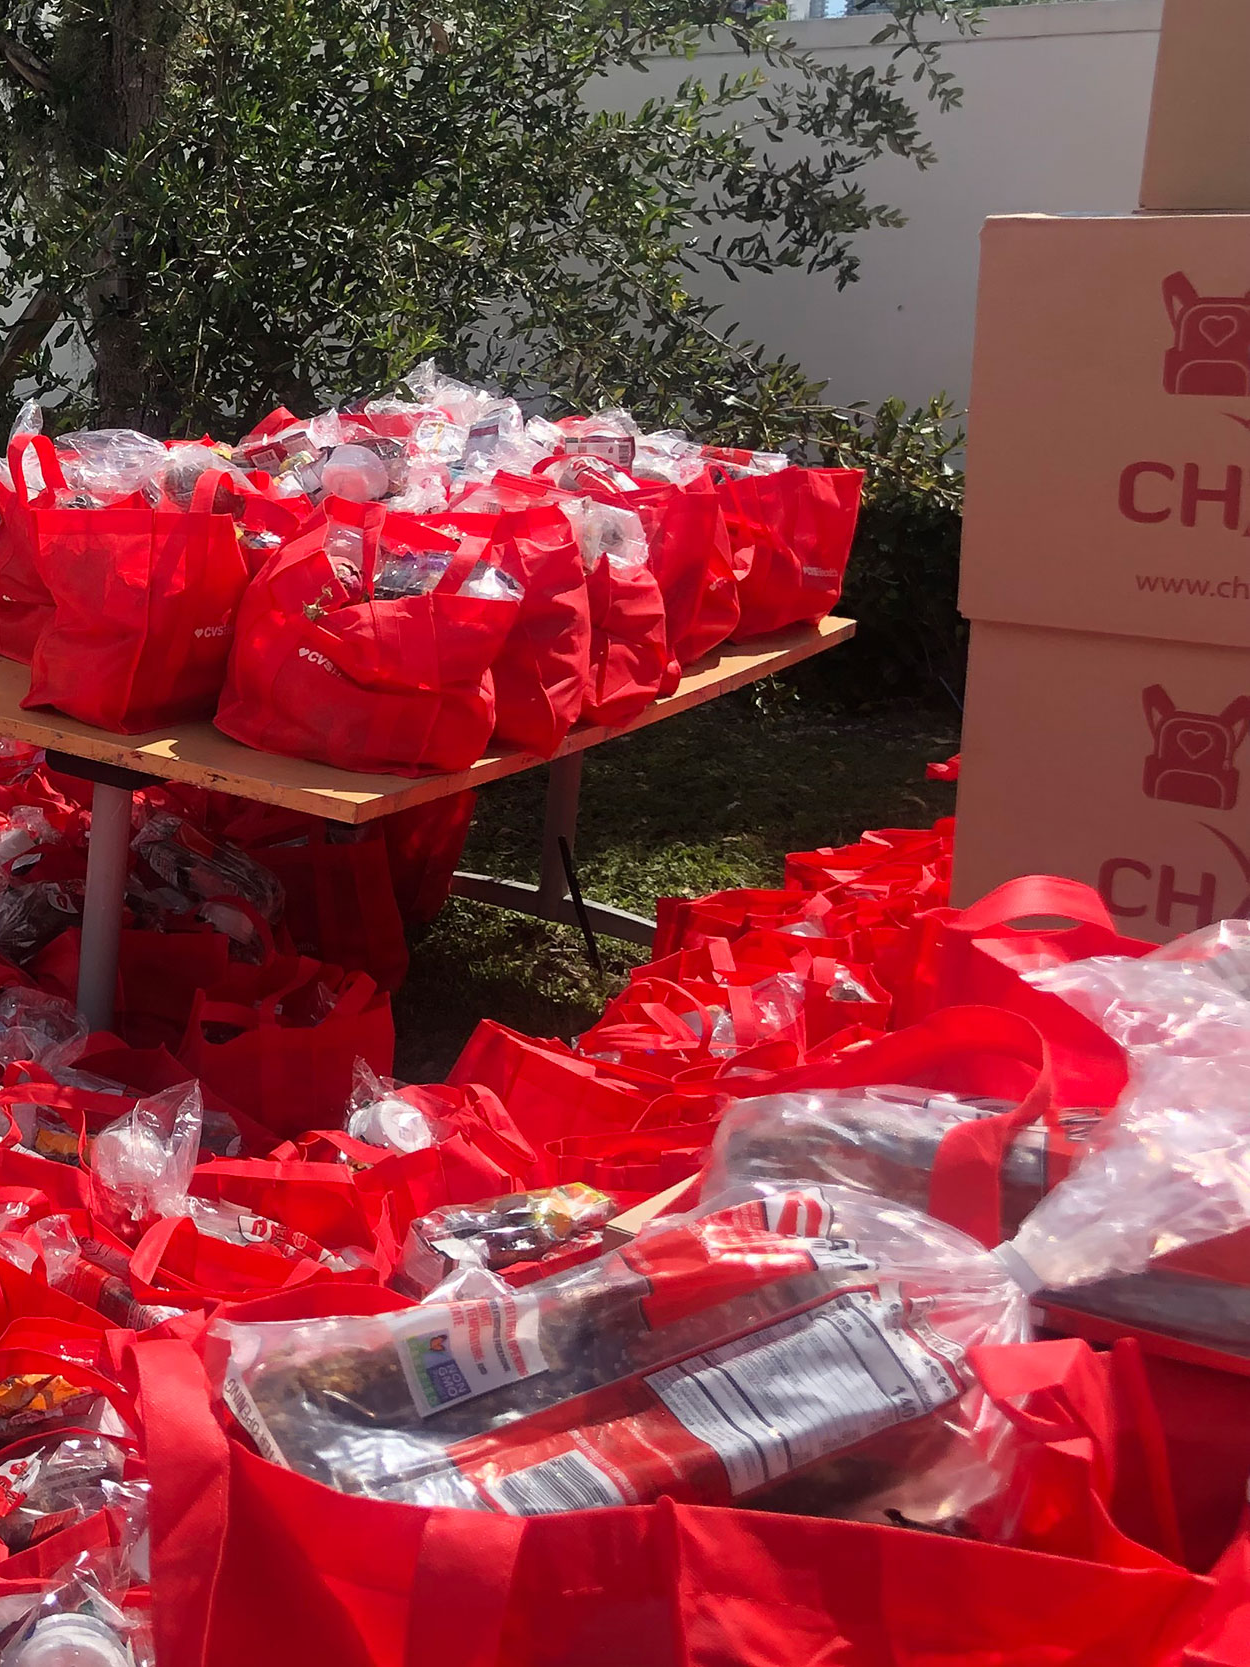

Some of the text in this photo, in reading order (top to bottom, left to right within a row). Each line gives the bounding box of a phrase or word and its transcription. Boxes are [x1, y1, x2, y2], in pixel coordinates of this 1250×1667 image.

[1118, 461, 1250, 537] CH
[204, 626, 224, 638] CVS
[308, 651, 333, 672] CVS
[506, 1340, 529, 1377] OPENING
[437, 1366, 458, 1398] GMO
[447, 1363, 467, 1394] NON
[222, 1378, 261, 1434] OPENING
[889, 1384, 919, 1419] 140
